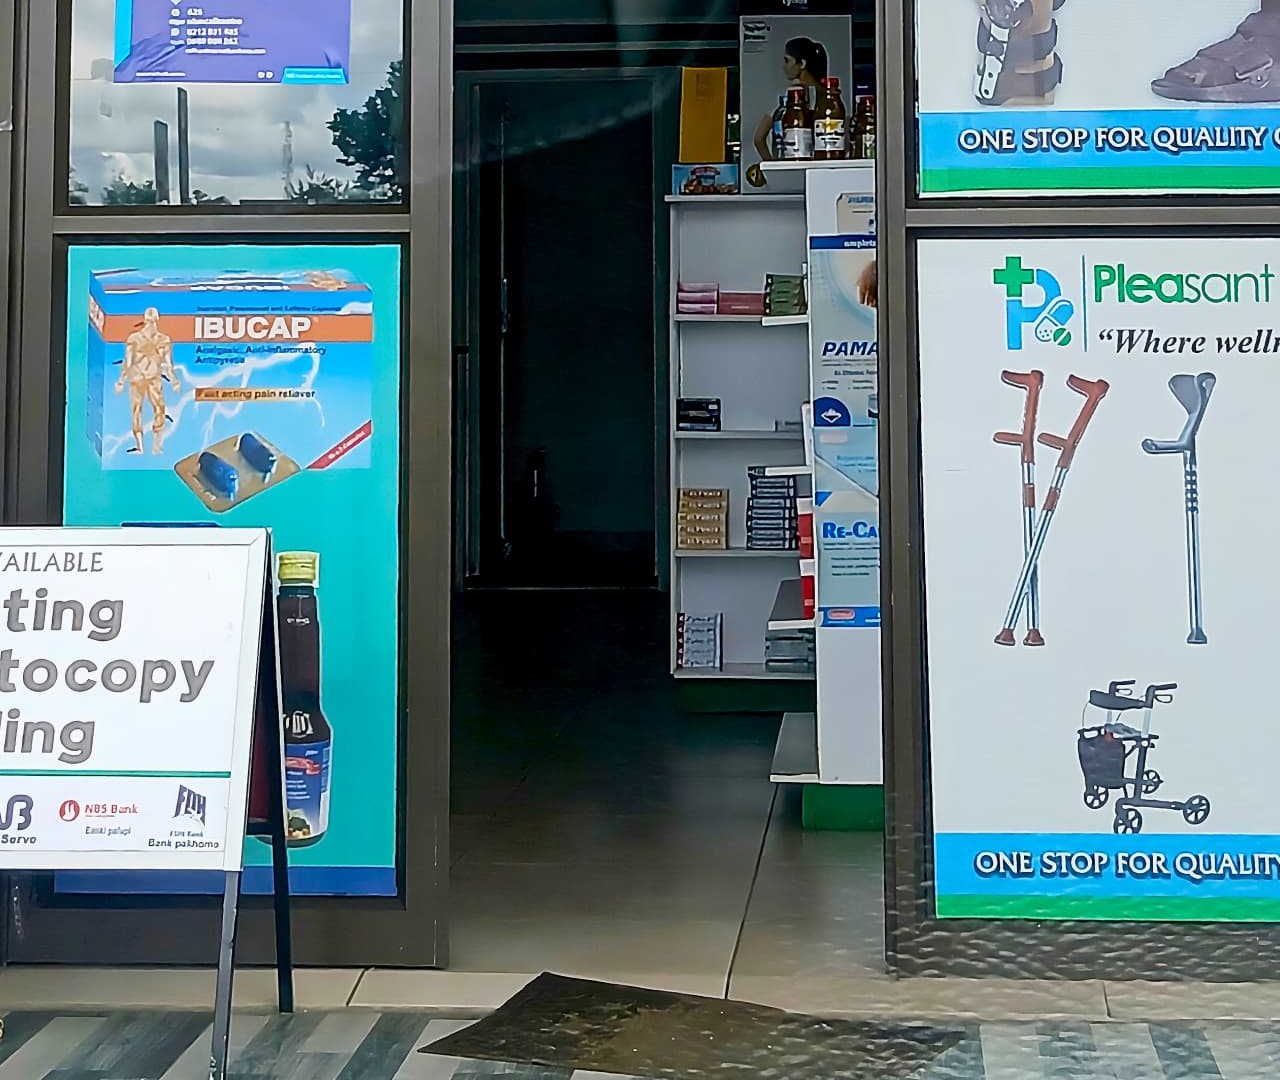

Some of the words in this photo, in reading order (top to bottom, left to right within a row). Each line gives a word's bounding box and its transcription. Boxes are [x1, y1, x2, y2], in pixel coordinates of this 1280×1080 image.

[958, 127, 1017, 151] ONE
[1022, 126, 1089, 151] STOP
[1095, 126, 1150, 150] FOR
[1152, 125, 1267, 155] QUALITY
[1093, 263, 1271, 304] Pleasant
[194, 316, 312, 339] IBUCAP
[254, 389, 276, 400] pain
[84, 803, 108, 814] NBS
[111, 803, 138, 814] Bank
[148, 838, 172, 848] Bank
[975, 851, 1035, 876] ONE
[1041, 851, 1108, 877] STOP
[1116, 852, 1171, 877] FOR
